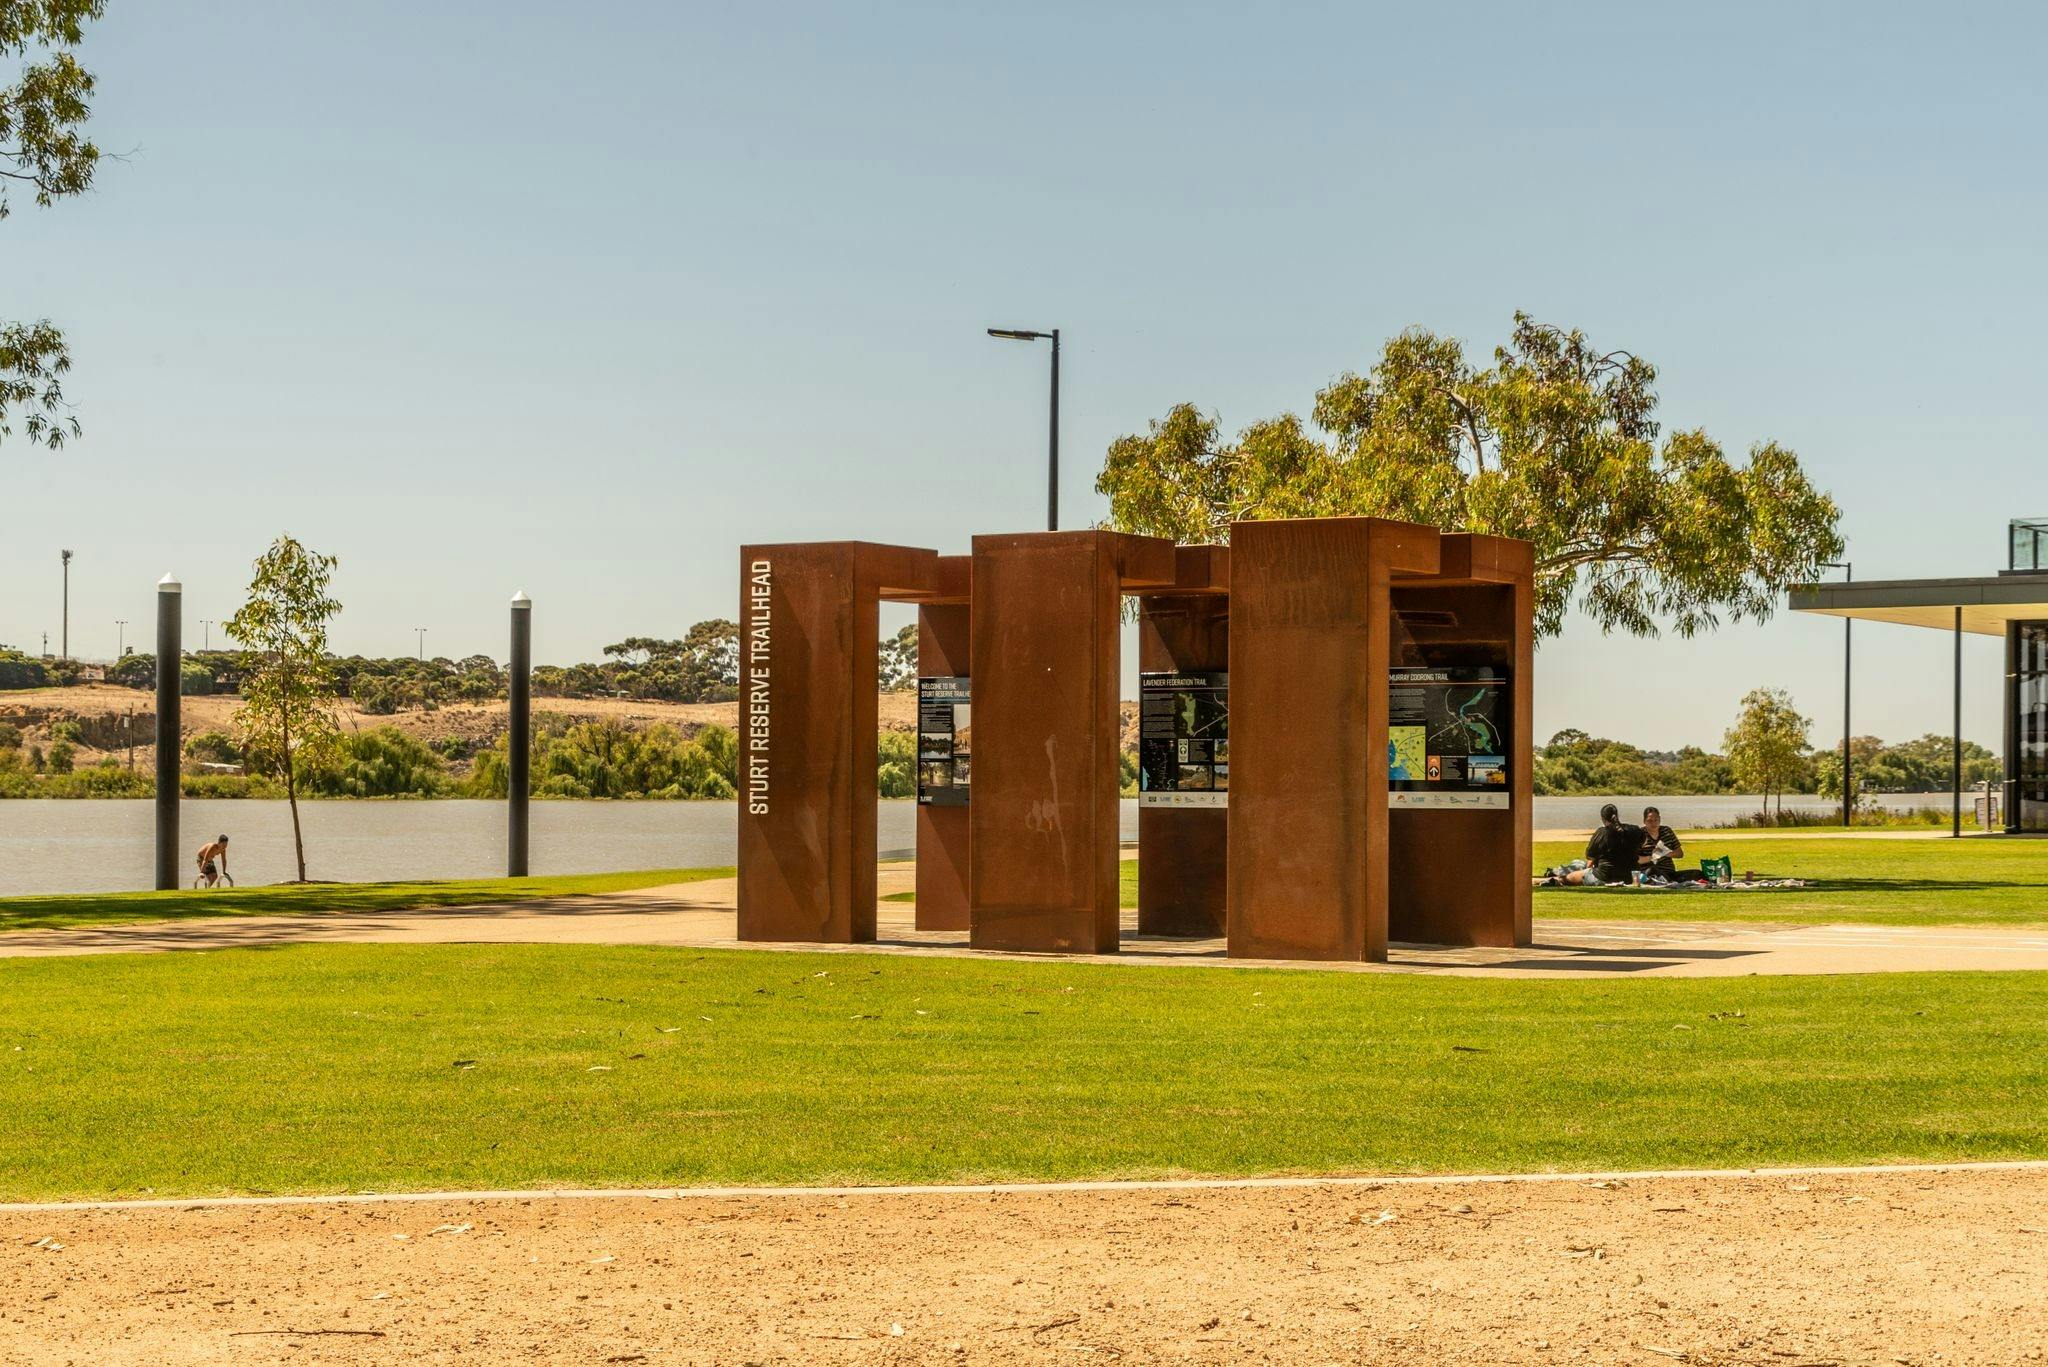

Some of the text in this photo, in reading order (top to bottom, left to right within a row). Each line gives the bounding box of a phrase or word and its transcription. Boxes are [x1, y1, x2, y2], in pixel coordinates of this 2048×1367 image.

[749, 560, 771, 815] STURT RESERVE TRAILHEAD
